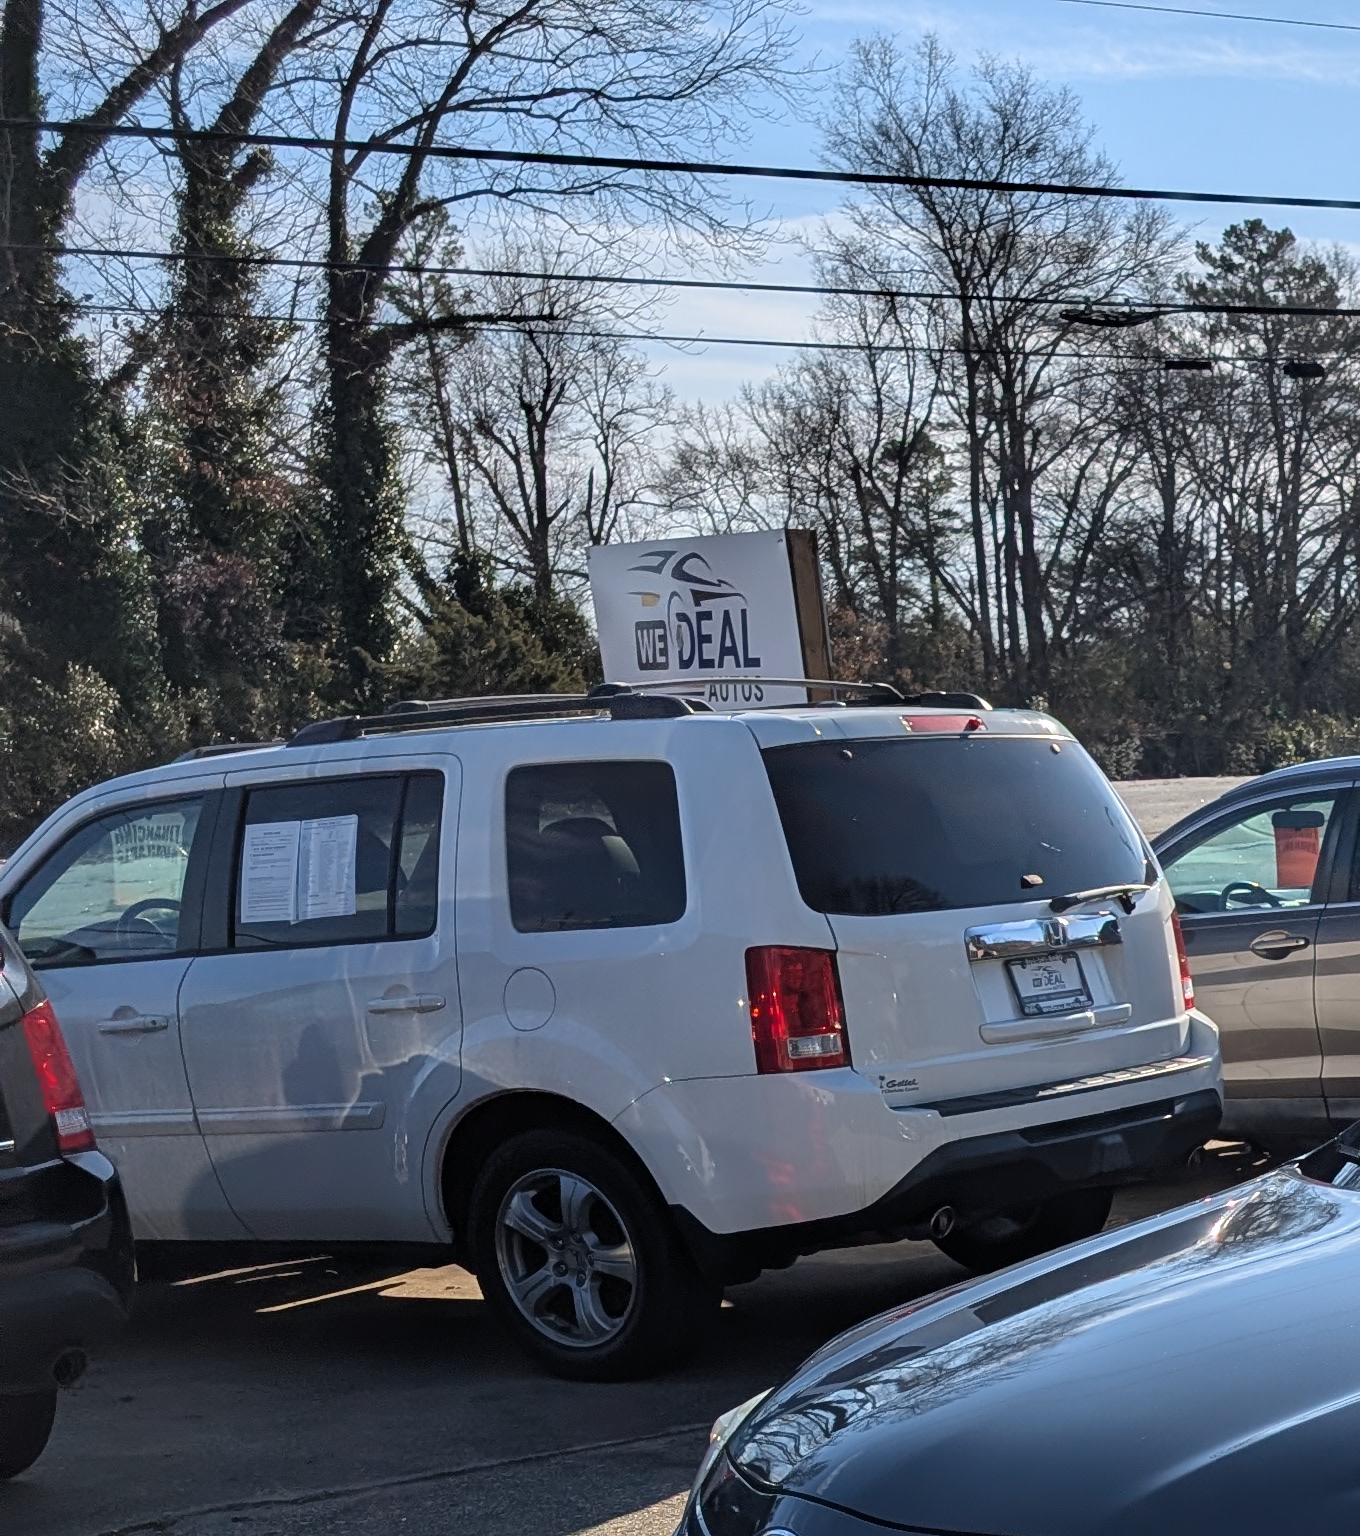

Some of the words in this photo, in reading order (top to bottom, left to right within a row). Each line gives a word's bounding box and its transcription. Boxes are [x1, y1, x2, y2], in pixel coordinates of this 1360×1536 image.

[637, 627, 667, 664] WE
[676, 609, 761, 669] DEAL
[708, 675, 764, 702] AUTOS
